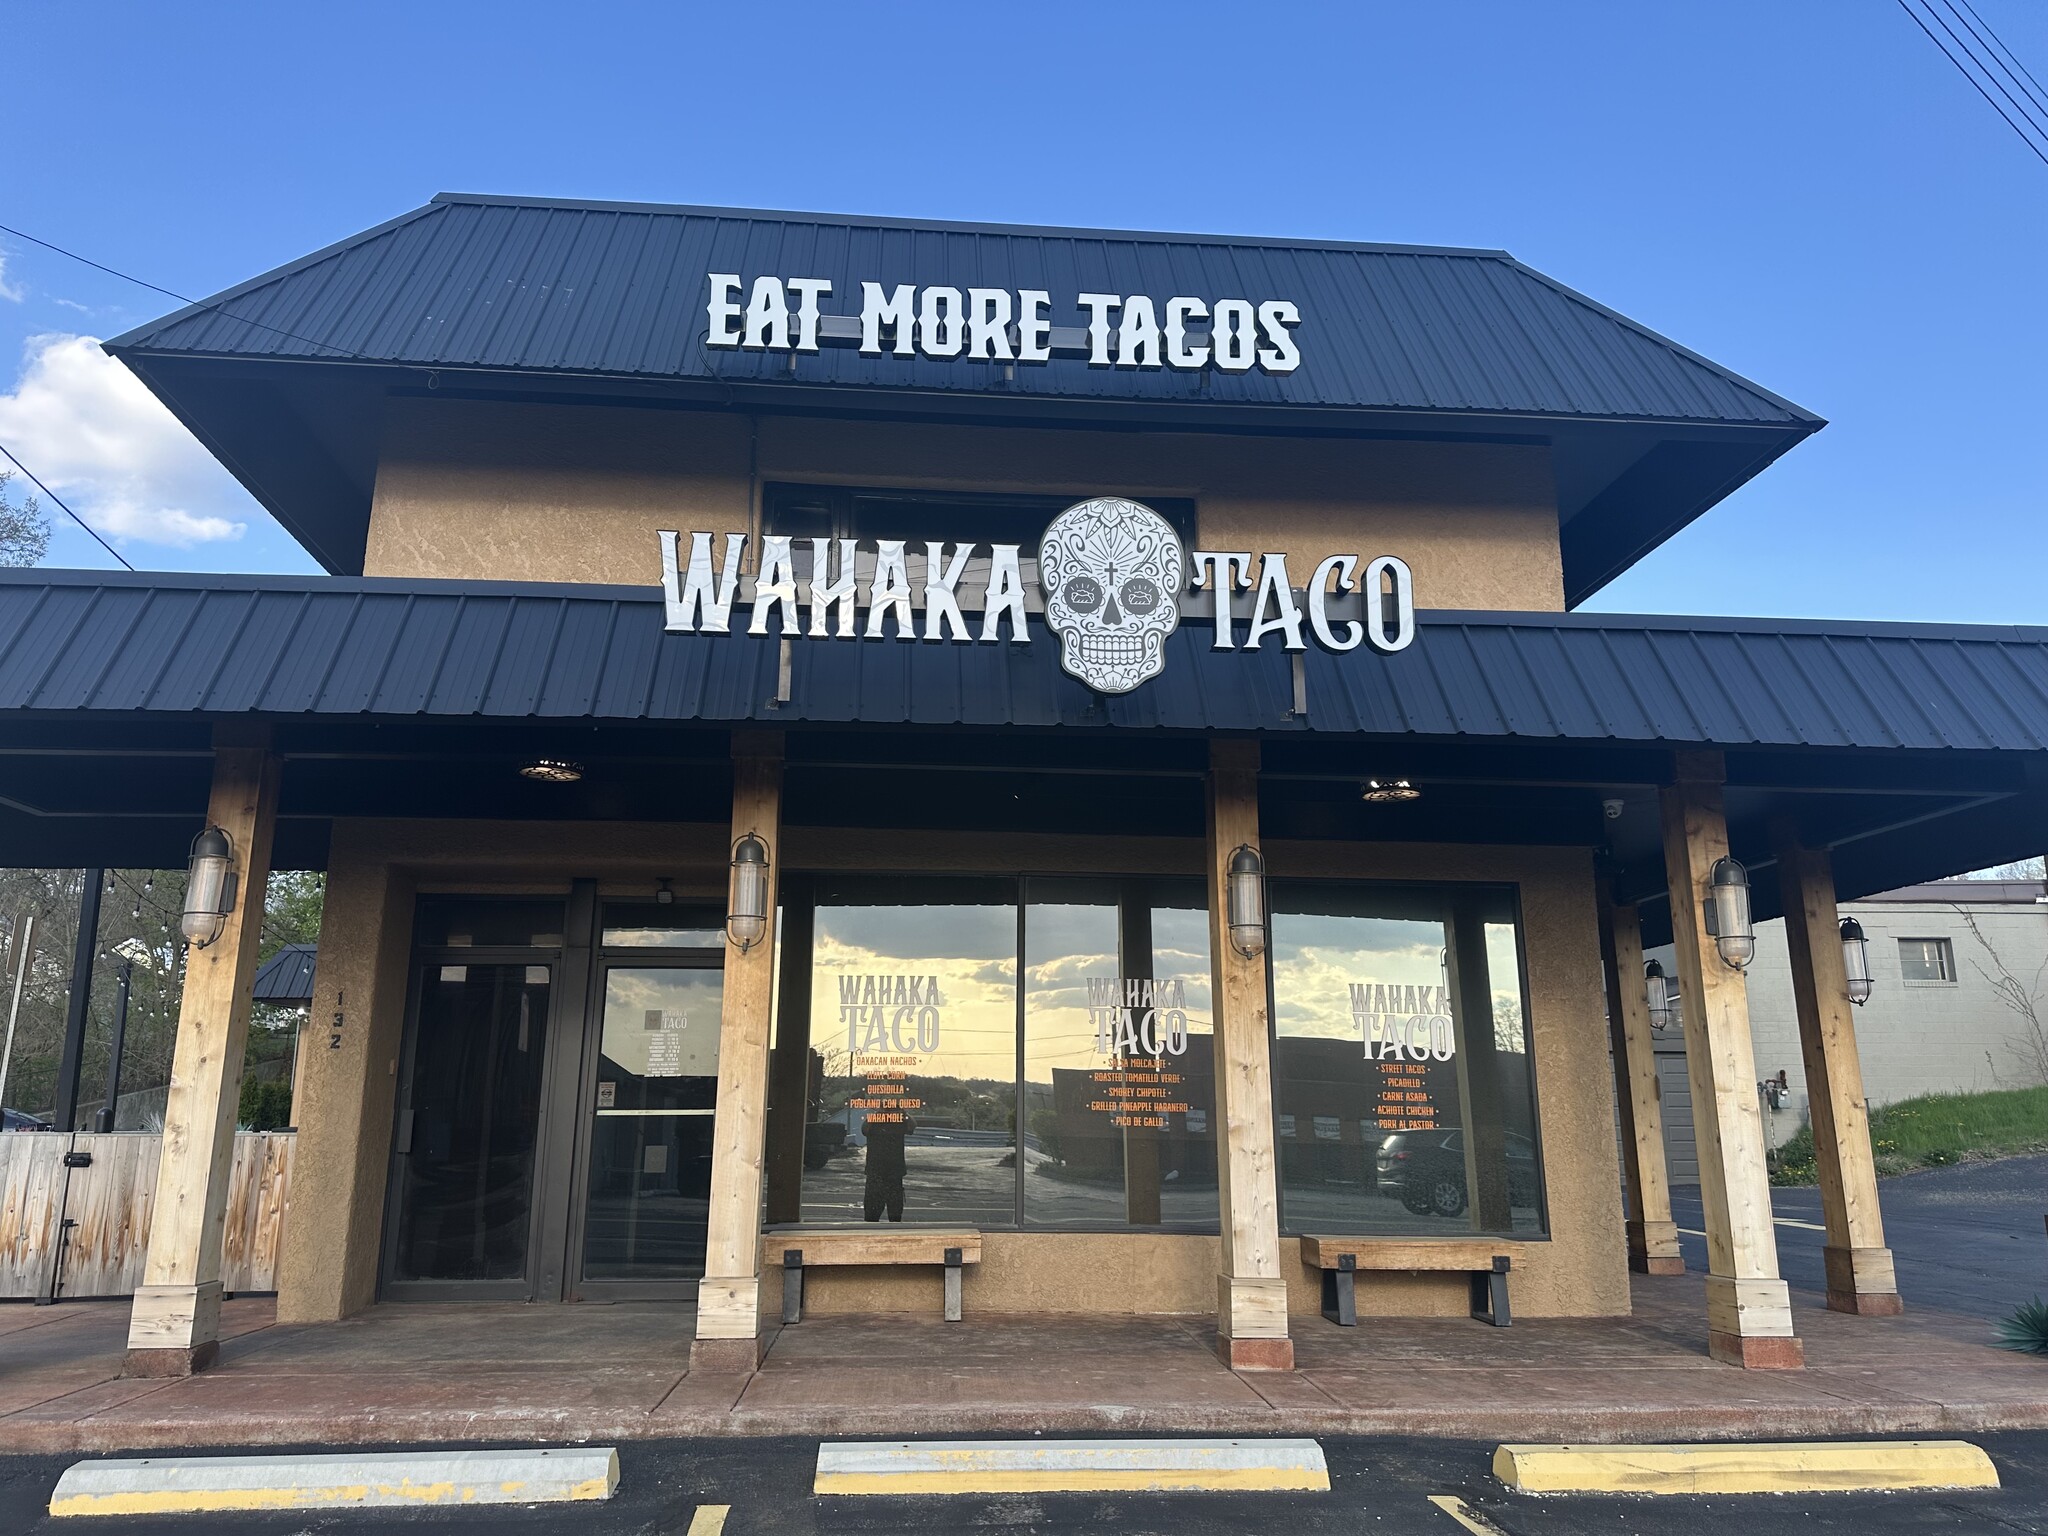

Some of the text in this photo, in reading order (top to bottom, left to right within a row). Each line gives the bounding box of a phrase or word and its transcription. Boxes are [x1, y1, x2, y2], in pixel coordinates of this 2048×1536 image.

[705, 272, 1302, 372] EAT MORE TACOS
[656, 530, 1415, 651] WAHAKA TACO
[838, 975, 940, 1005] WAHAKA
[1086, 978, 1186, 1008] WAHAKA
[1348, 983, 1451, 1015] WAHAKA
[662, 1017, 688, 1029] TACO
[838, 1006, 940, 1053] TACO
[1088, 1007, 1188, 1056] TACO
[1352, 1013, 1453, 1062] TACO
[856, 1056, 917, 1066] OAXACAN NACHOS
[1108, 1058, 1166, 1069] SALSA MOLCAJETE
[1380, 1063, 1426, 1074] STREET TACOS
[1094, 1072, 1180, 1083] ROASTED TOMATILLO VERDE
[1387, 1077, 1421, 1088] PICADILLO
[1108, 1087, 1166, 1098] SMOKEY CHIPOTLE
[1382, 1091, 1428, 1102] CARNE ASADA
[850, 1098, 921, 1109] POBLANO CON QUESO
[1091, 1101, 1188, 1112] GRILLED PINEAPPLE HABANERO
[1377, 1105, 1434, 1116] ACHIOTE CHICKEN
[1115, 1116, 1164, 1127] PICO DE GALLO
[1378, 1119, 1435, 1130] PORK AL PASTOR
